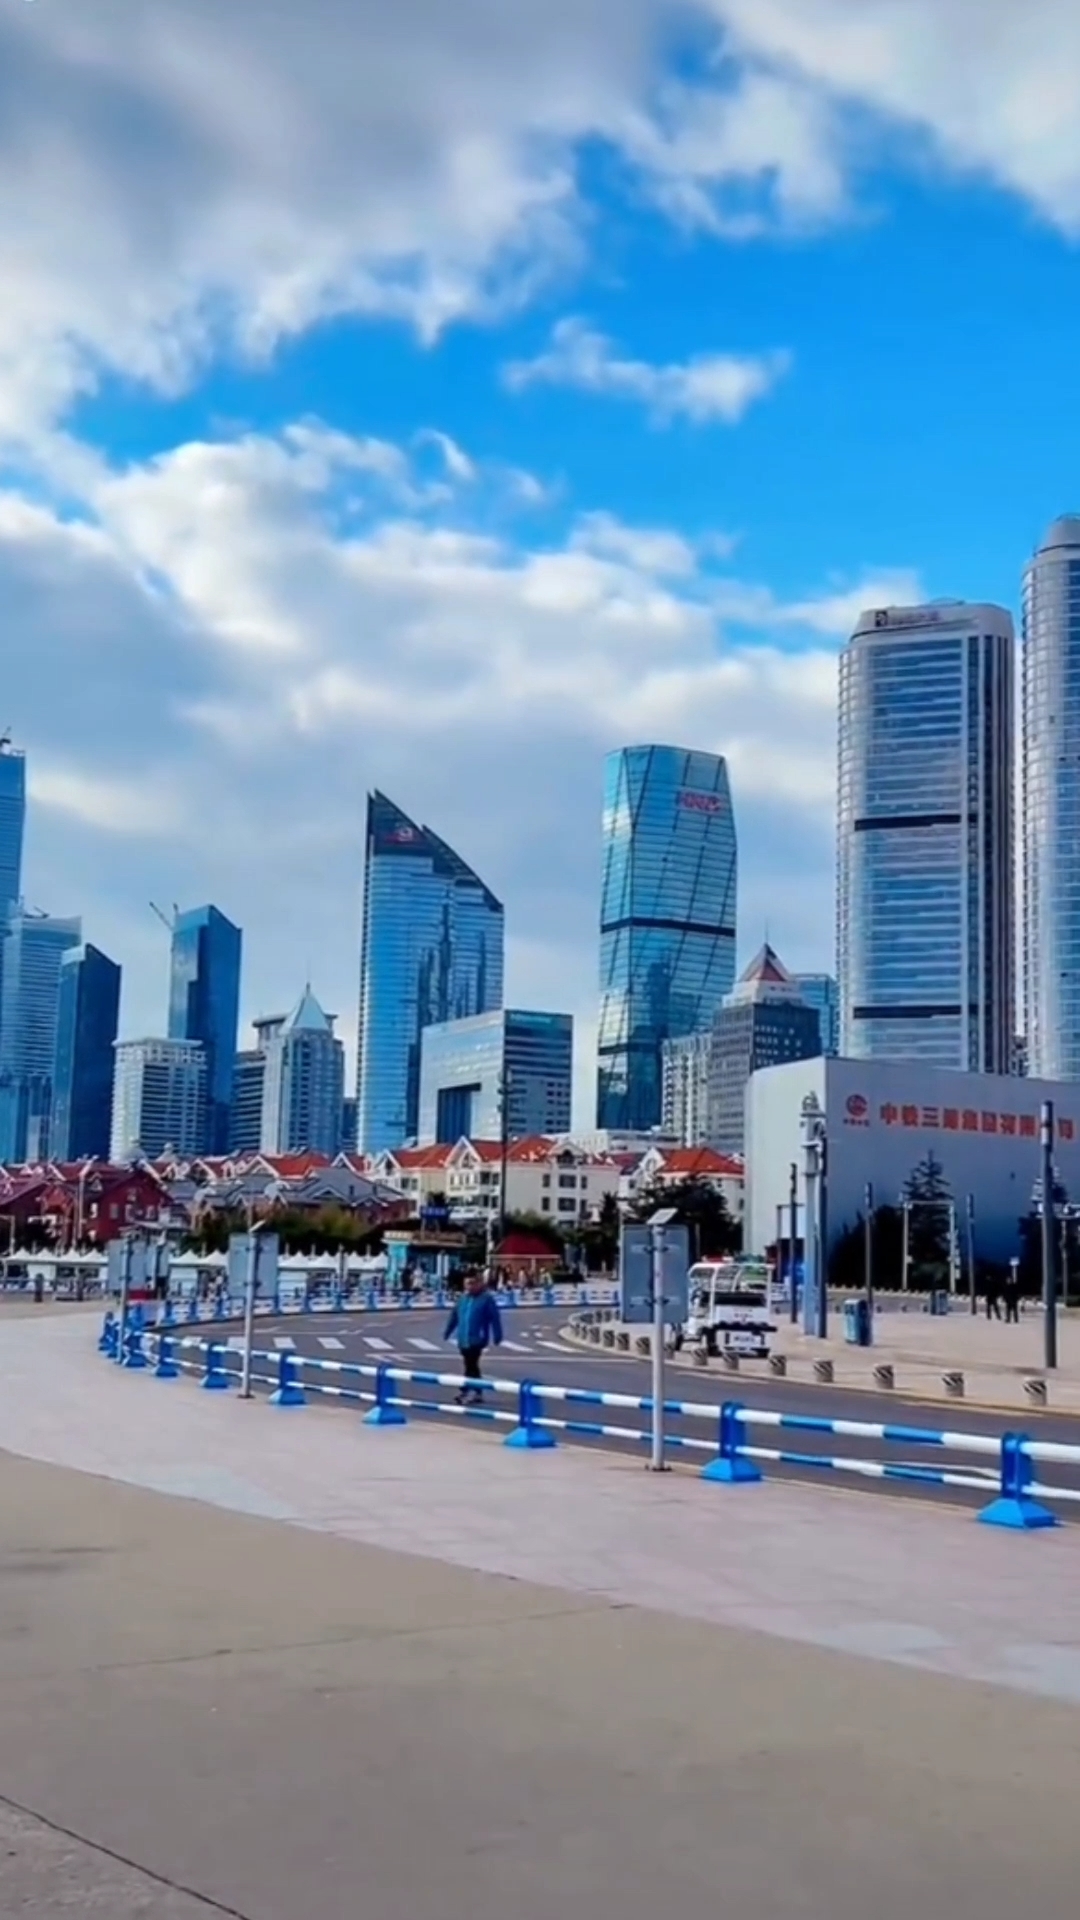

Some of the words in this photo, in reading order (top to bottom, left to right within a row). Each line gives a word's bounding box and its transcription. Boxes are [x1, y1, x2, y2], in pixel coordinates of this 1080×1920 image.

[880, 1103, 1074, 1139] 中铁三局集团有限司
